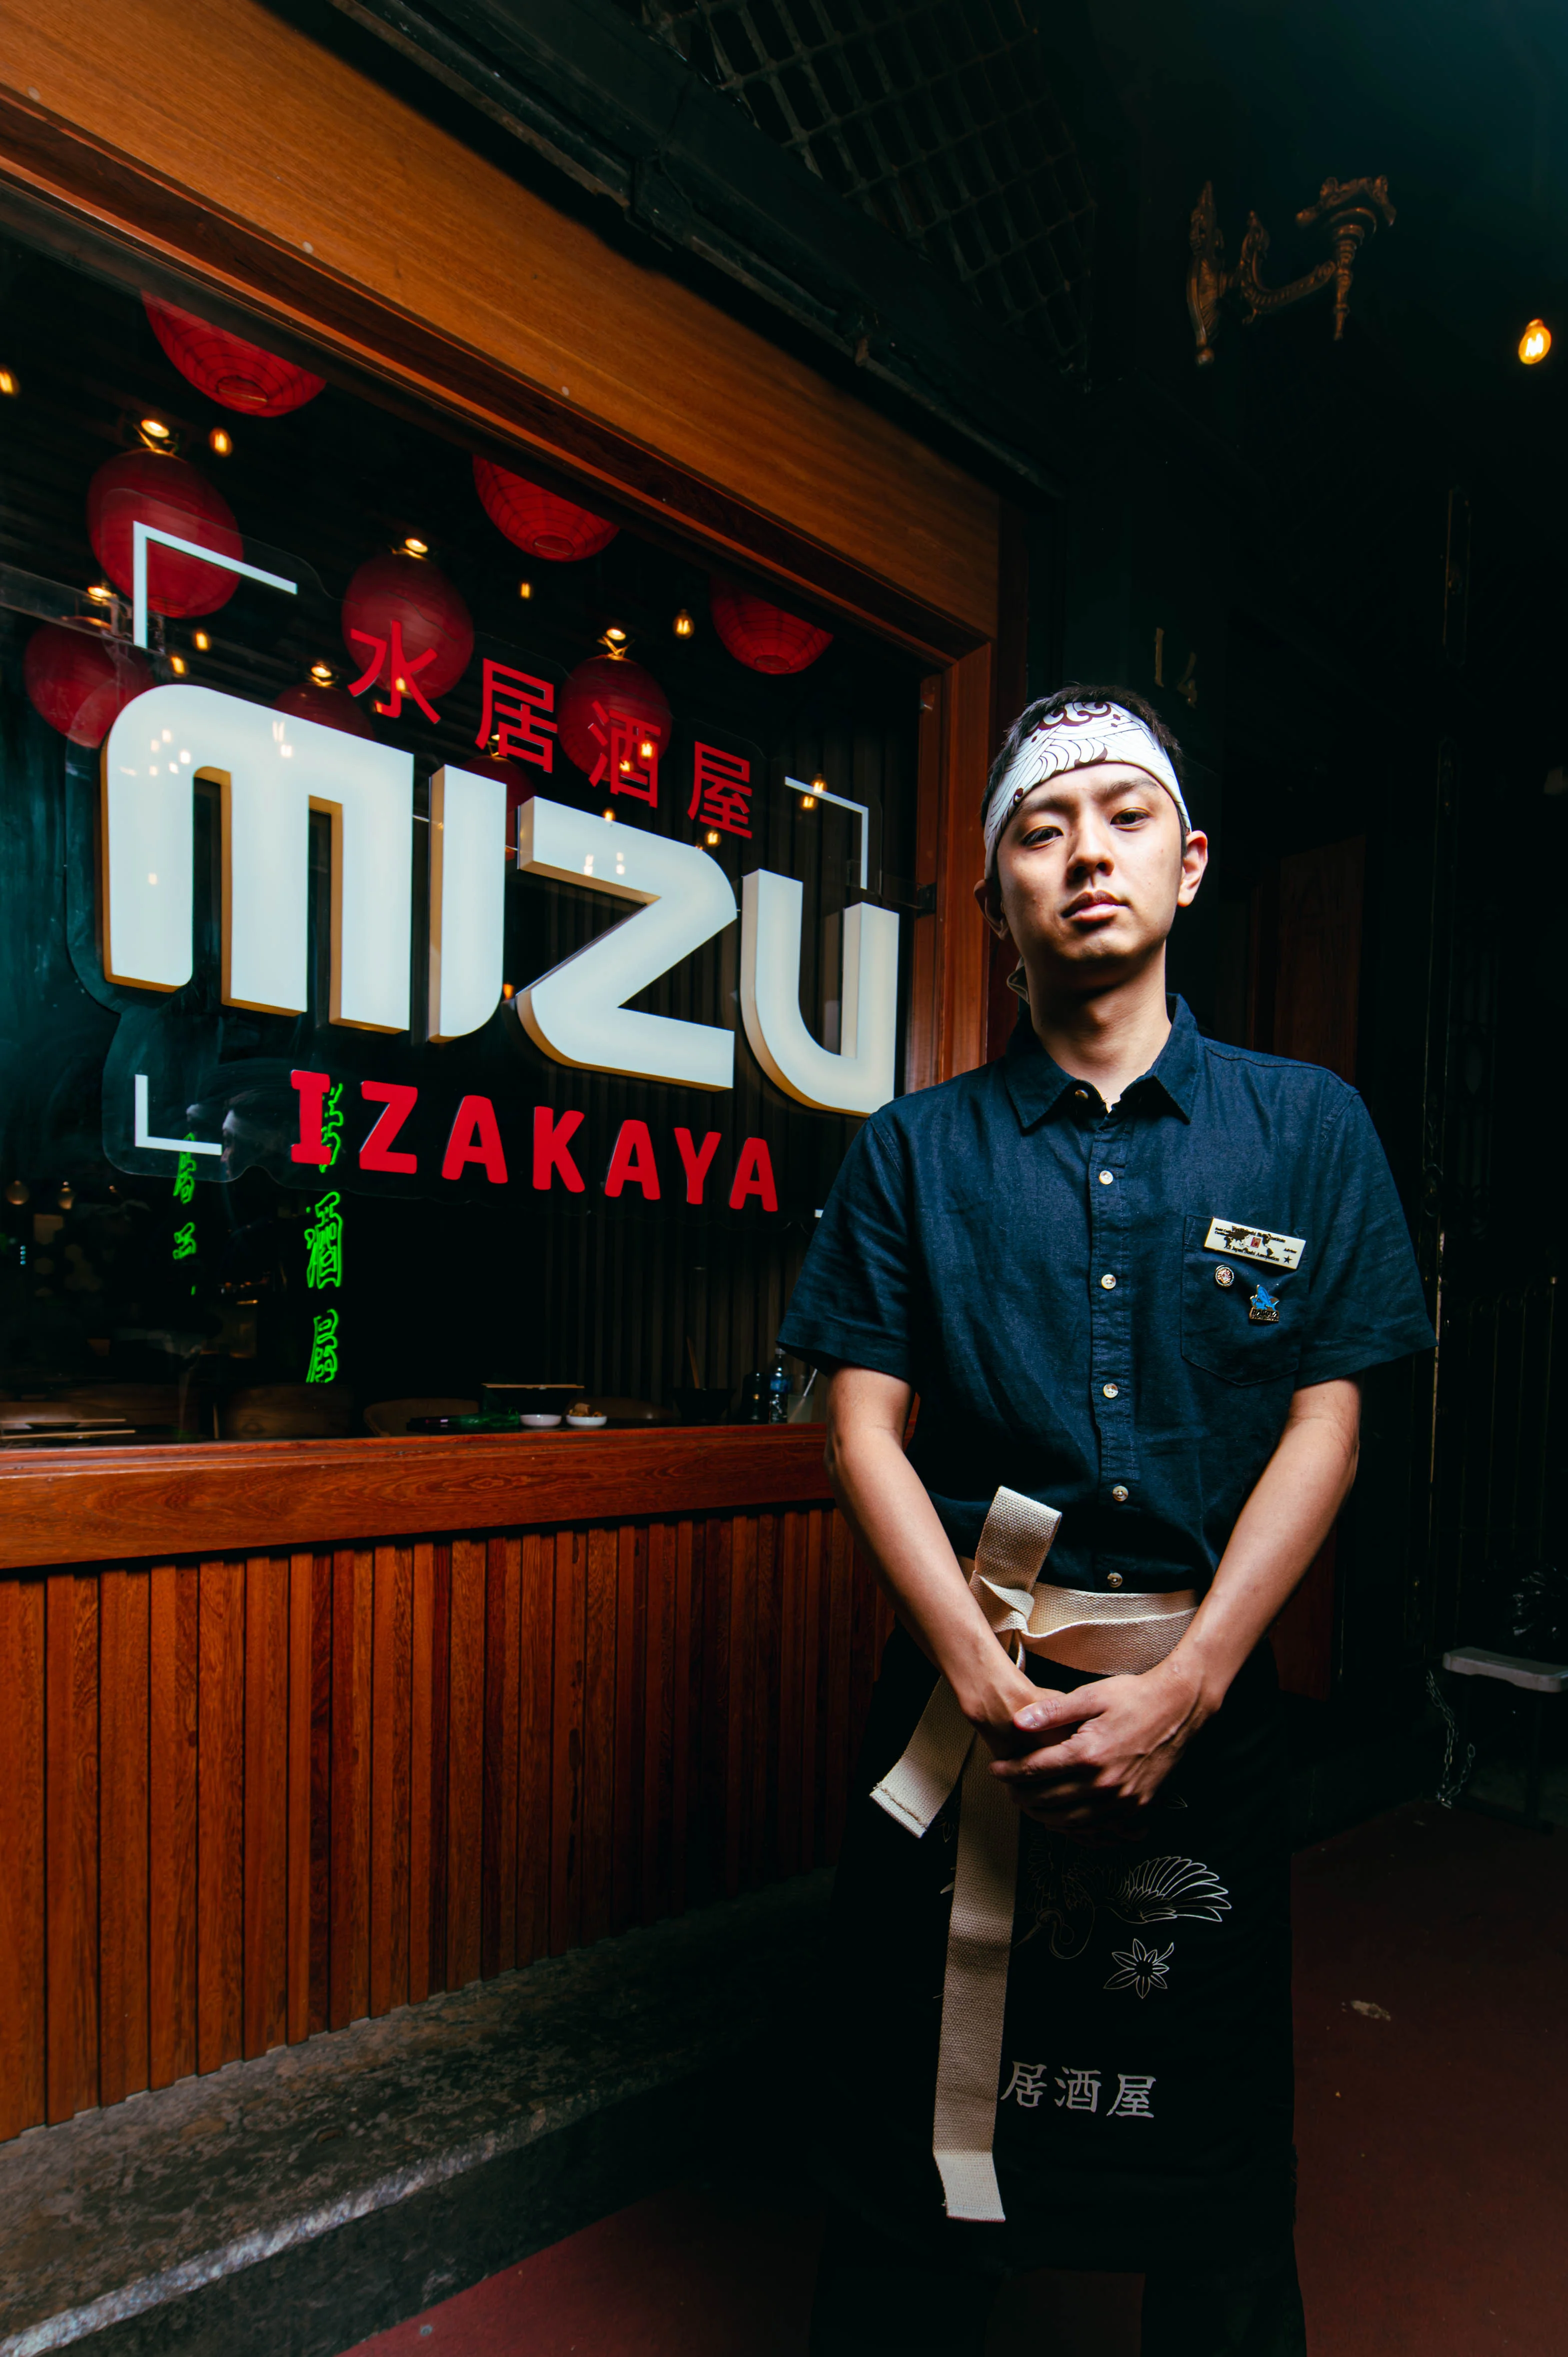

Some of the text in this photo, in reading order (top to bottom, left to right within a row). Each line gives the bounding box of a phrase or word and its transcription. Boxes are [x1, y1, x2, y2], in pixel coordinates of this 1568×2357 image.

[348, 621, 753, 839] 水居酒屋
[103, 684, 899, 1117] MIZU
[290, 1069, 779, 1212] IZAKAYA
[1000, 2061, 1156, 2118] 居酒屋
